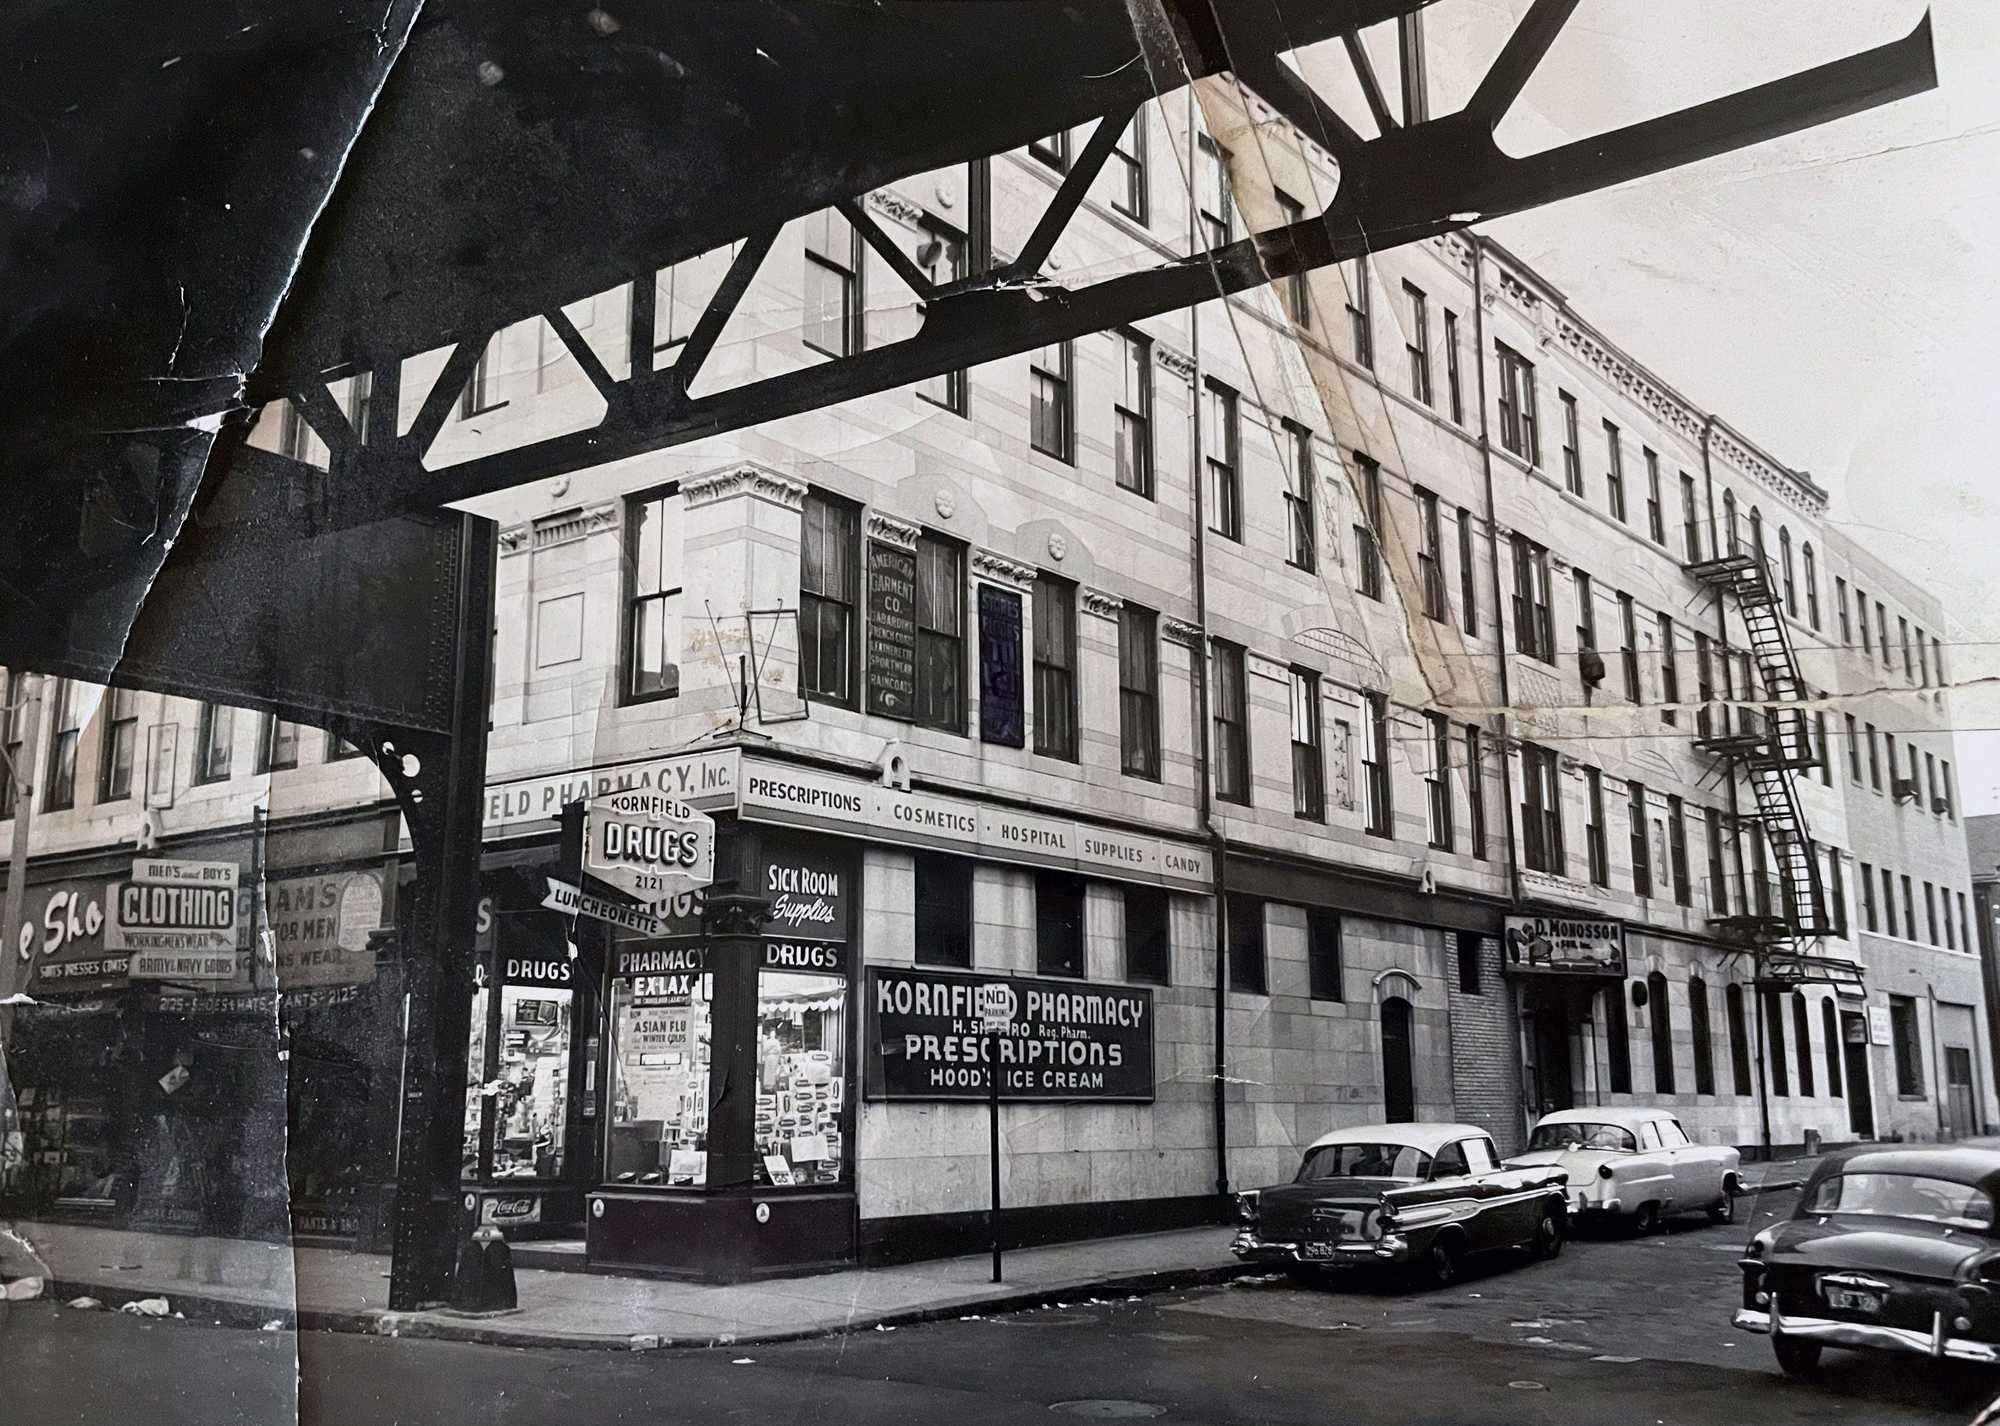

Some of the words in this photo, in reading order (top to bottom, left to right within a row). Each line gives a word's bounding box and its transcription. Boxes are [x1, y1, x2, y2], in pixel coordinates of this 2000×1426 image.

[870, 553, 914, 581] AMERICAN
[871, 573, 914, 604] GARMENT
[884, 596, 903, 615] CO.
[748, 778, 862, 813] PRESCRIPTIONS
[611, 797, 690, 819] KORNFIELD
[605, 822, 699, 867] DRUGS
[894, 804, 975, 832] COSMETICS
[1001, 824, 1066, 849] HOSPITAL
[1085, 839, 1143, 863] SUPPLIES
[1165, 855, 1201, 873] CANDY
[203, 867, 231, 881] BOY'S
[636, 875, 663, 890] 2121
[768, 864, 799, 892] SICK
[801, 867, 838, 897] ROOM
[123, 887, 230, 926] CLOTHING
[555, 889, 657, 933] LUNCHEONETTE
[773, 894, 835, 928] Supplies
[43, 891, 104, 954] Sho
[303, 916, 336, 939] MEN
[1549, 919, 1618, 939] MONOSSON
[620, 948, 708, 973] PHARMACY
[766, 943, 838, 967] DRUGS
[65, 961, 99, 977] DRESSES
[140, 958, 169, 974] ARMY
[177, 958, 201, 976] NAVY
[507, 959, 571, 982] DRUGS
[877, 980, 1017, 1019] KORNFIED
[1027, 990, 1143, 1028] PHARMACY
[986, 990, 1006, 1004] NO
[634, 1020, 667, 1033] ASIAN
[670, 1020, 686, 1033] FLU
[953, 1020, 966, 1034] H.
[971, 1020, 1030, 1038] SHRO
[1039, 1024, 1059, 1040] Reg.
[1061, 1025, 1091, 1039] Pharm.
[643, 1034, 665, 1043] WINTER
[668, 1034, 686, 1043] COLDS
[905, 1034, 1122, 1067] PRESCRIPTIONS
[1007, 1070, 1034, 1088] ICE
[1042, 1070, 1103, 1089] CREAM
